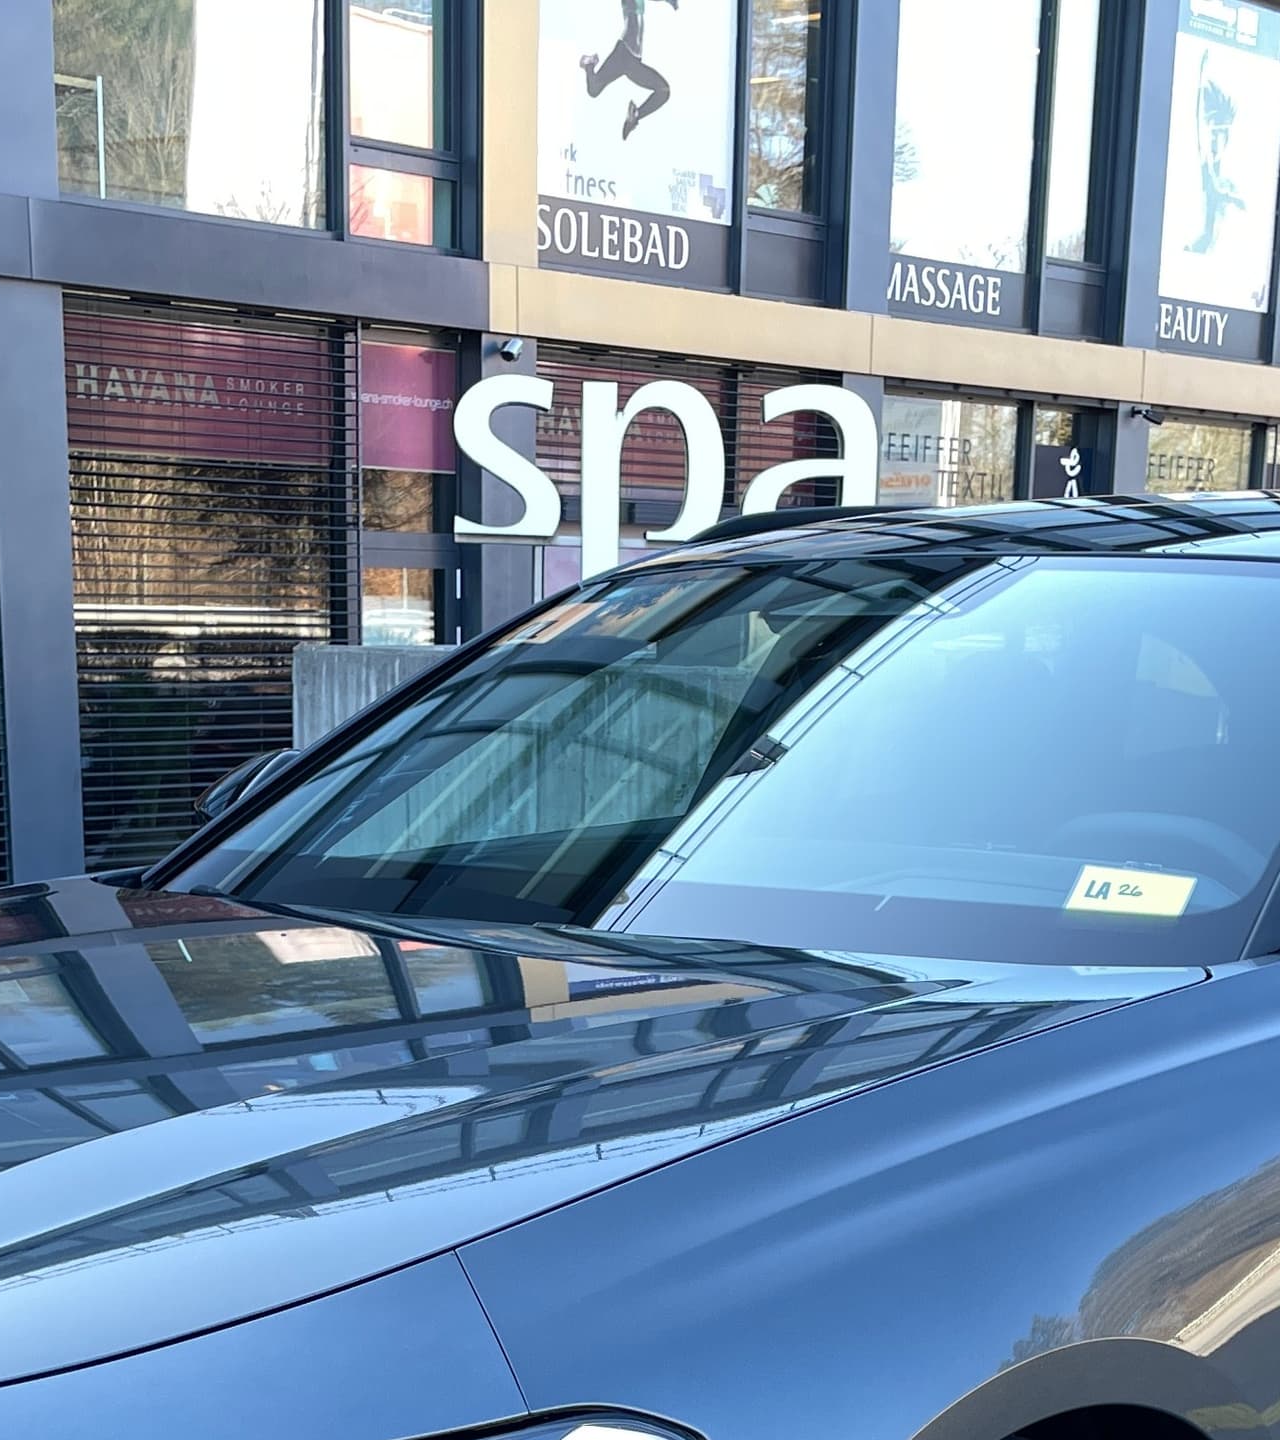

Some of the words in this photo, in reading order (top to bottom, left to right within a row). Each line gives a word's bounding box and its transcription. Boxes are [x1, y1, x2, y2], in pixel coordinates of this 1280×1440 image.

[565, 167, 617, 201] tness
[537, 204, 690, 270] SOLEBAD
[1155, 303, 1228, 346] EAUTY
[75, 363, 222, 408] HAVANA
[226, 377, 305, 396] SMOKER
[886, 433, 972, 466] FEIFFER
[1148, 453, 1216, 482] FEIFFER
[453, 374, 878, 590] spa
[1084, 880, 1112, 900] LA
[1118, 883, 1144, 897] 26
